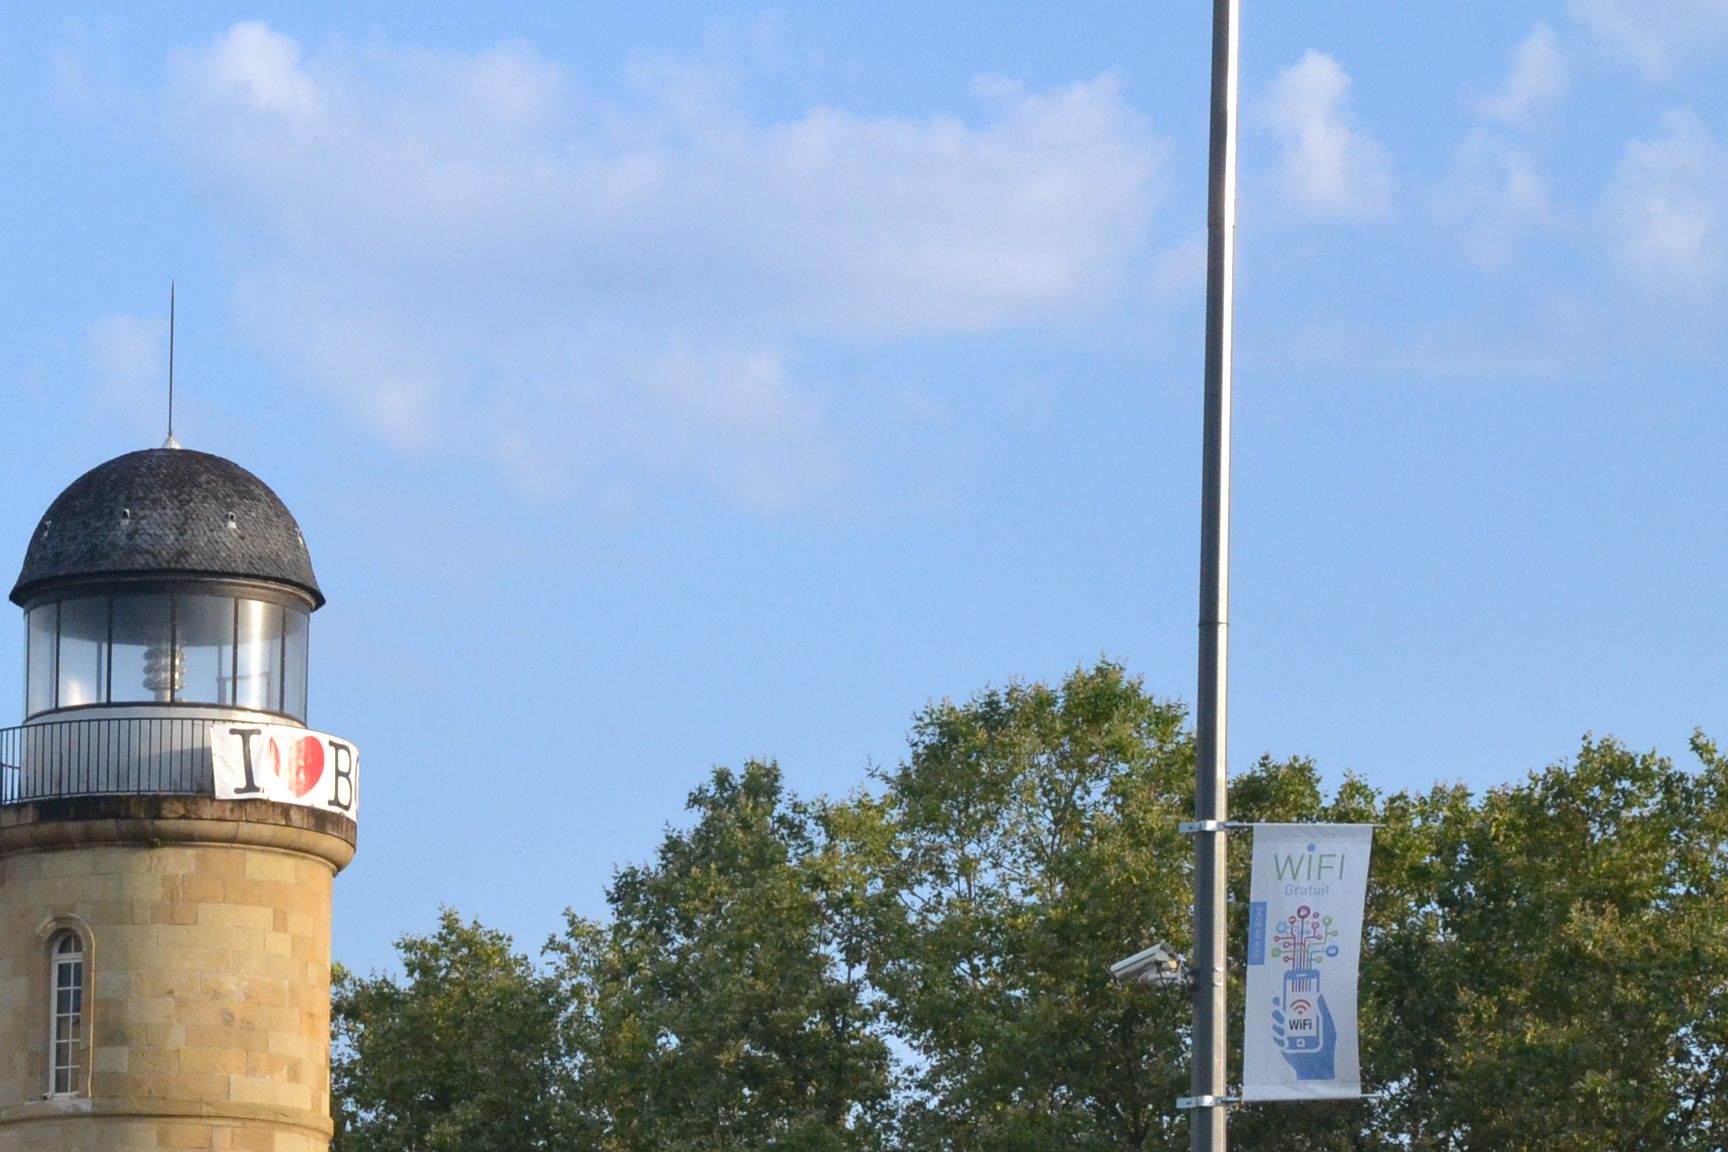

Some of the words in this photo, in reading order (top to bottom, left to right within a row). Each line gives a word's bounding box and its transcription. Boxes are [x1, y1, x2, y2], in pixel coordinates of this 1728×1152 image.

[229, 728, 262, 794] I
[328, 740, 360, 812] B
[1284, 884, 1330, 896] Gratuit
